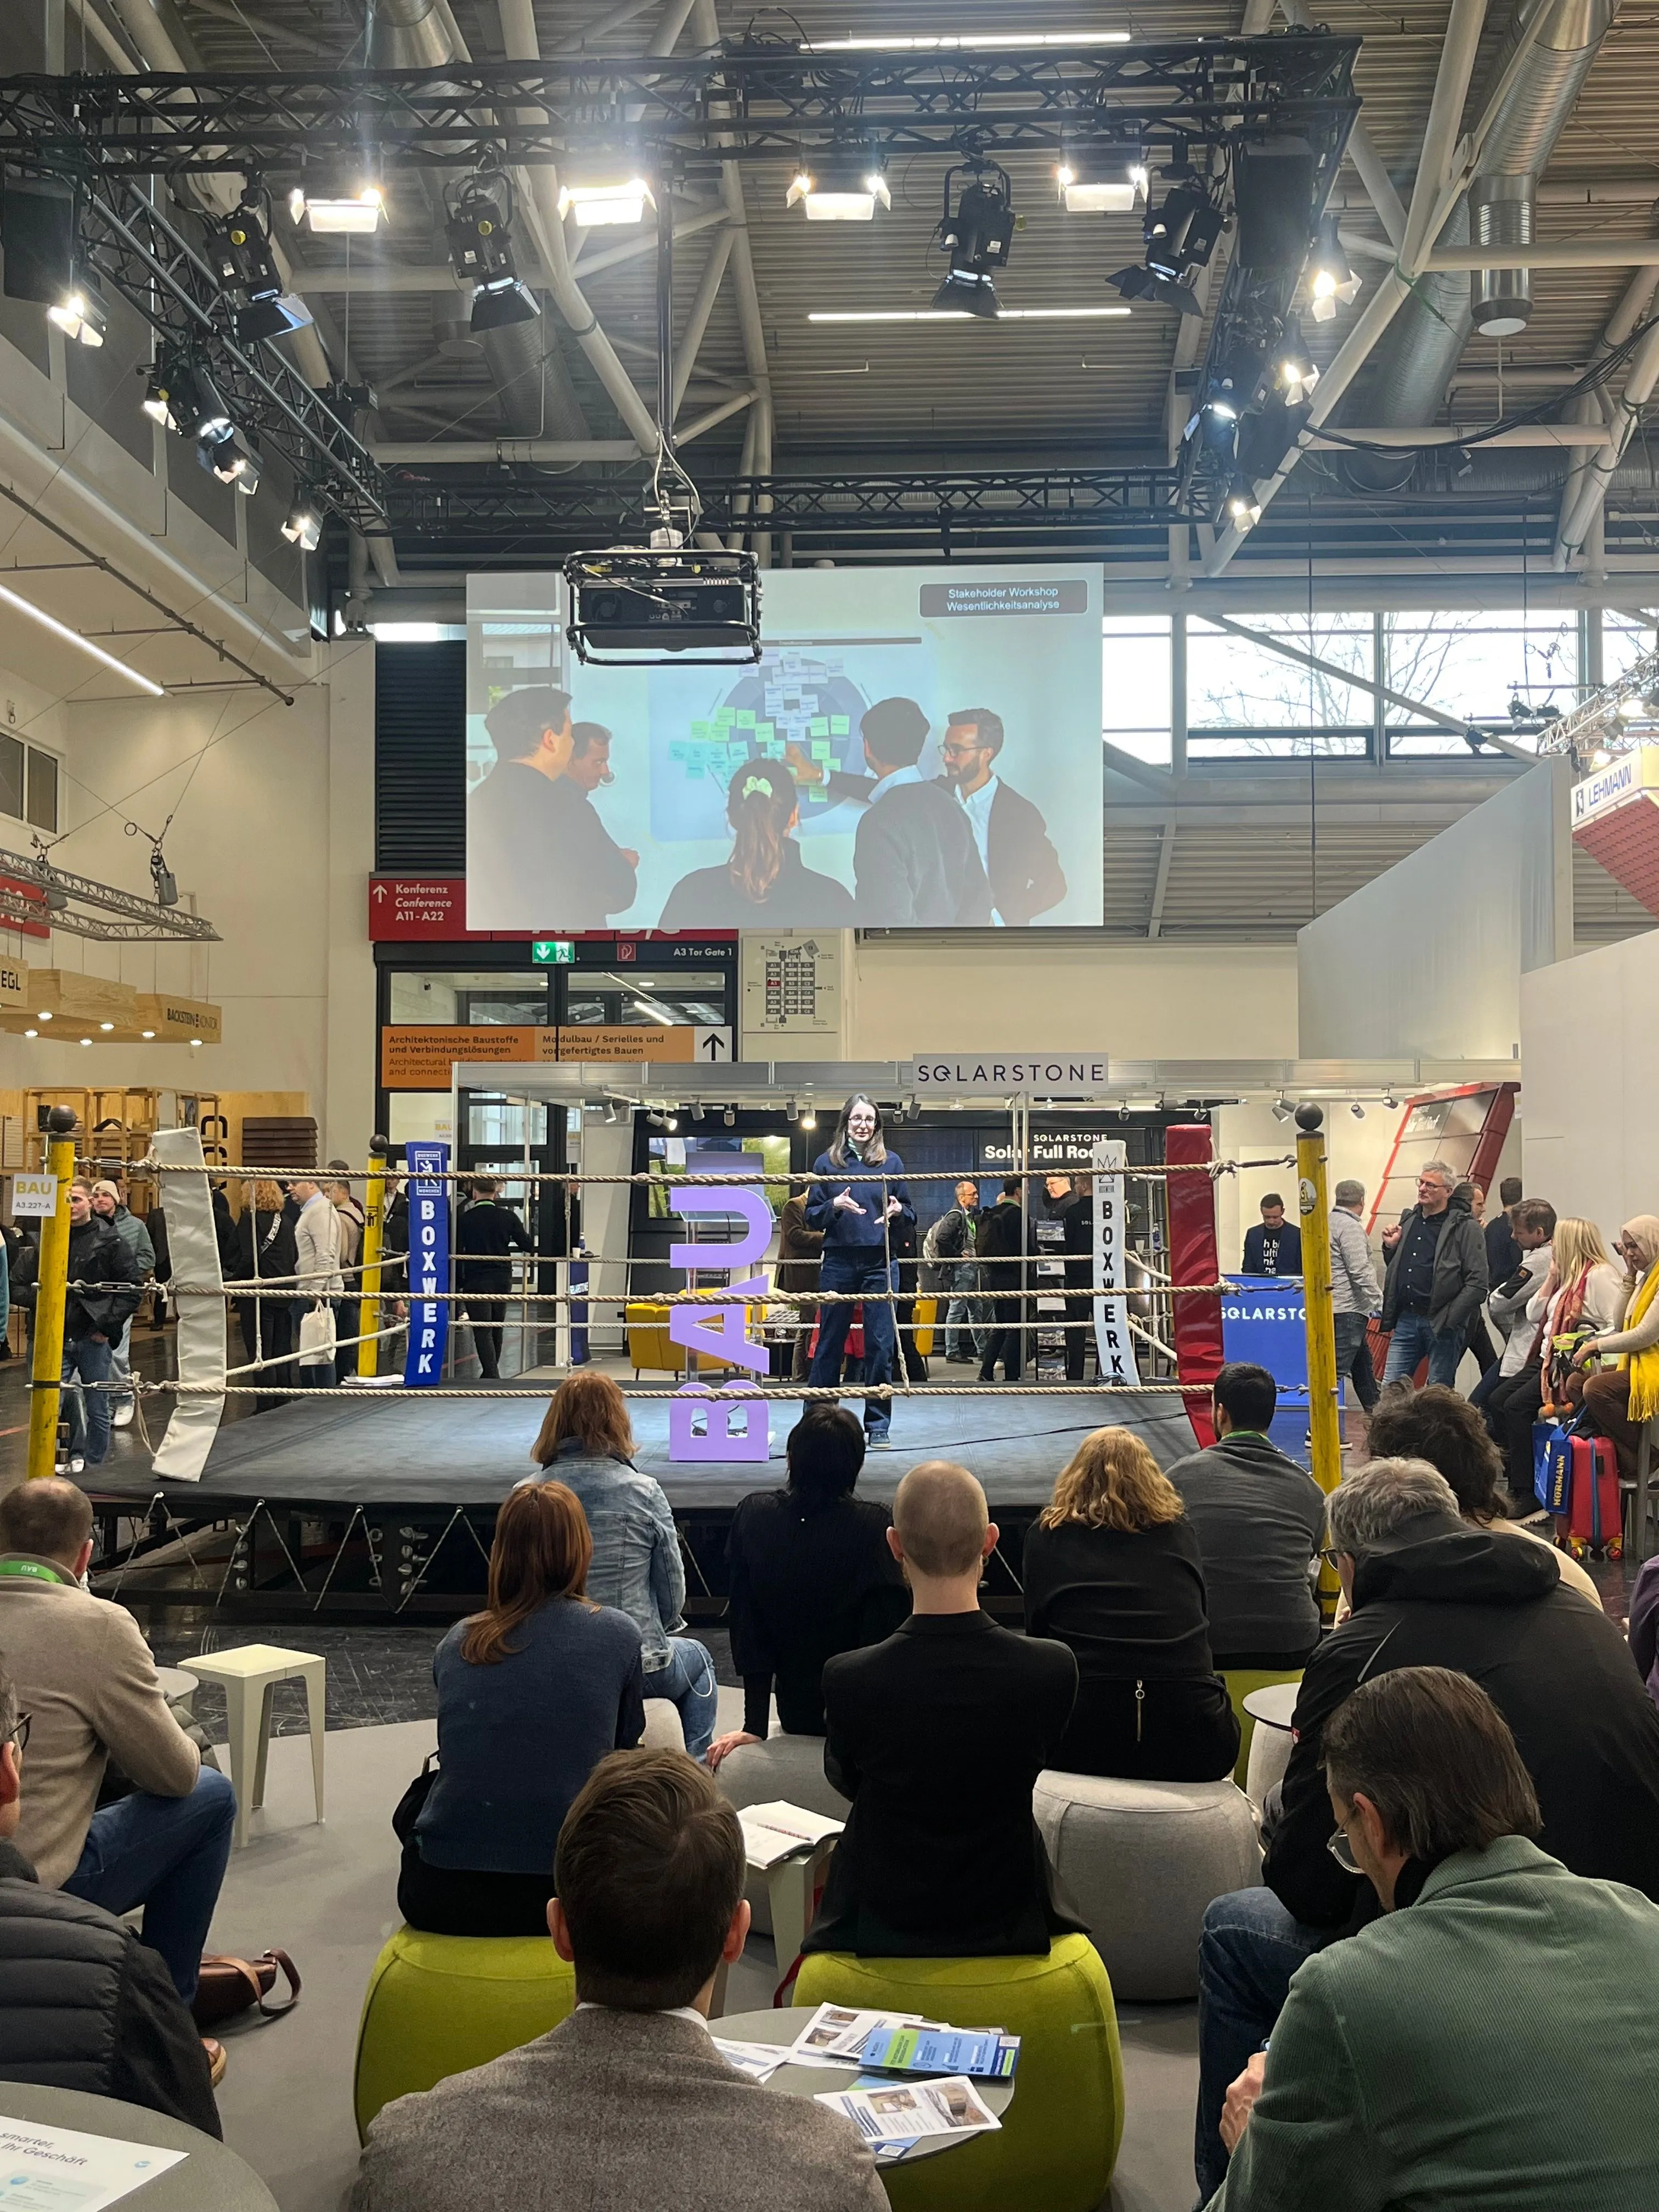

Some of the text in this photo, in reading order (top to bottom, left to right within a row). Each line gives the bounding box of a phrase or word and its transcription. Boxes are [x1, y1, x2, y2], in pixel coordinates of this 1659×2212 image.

[949, 587, 1058, 599] Stakeholder Workshop
[946, 600, 1060, 611] Wesentlichkeitsanalyse
[1589, 763, 1632, 806] LEHMANN
[396, 883, 448, 894] Konferenz
[395, 898, 453, 908] Conference
[674, 948, 732, 956] A3 Tor Gate 1
[410, 1046, 511, 1056] Verbindungslösungen
[389, 1058, 446, 1066] Architectural
[985, 1145, 1030, 1159] Sola
[1034, 1144, 1063, 1159] Full
[16, 1181, 52, 1194] BAU
[417, 1200, 437, 1373] BOXWERK
[1102, 1201, 1124, 1373] BOXWERK
[669, 1187, 772, 1462] BAU
[0, 2132, 55, 2149] smarter,
[1, 2142, 88, 2165] Ihr Geschäft
